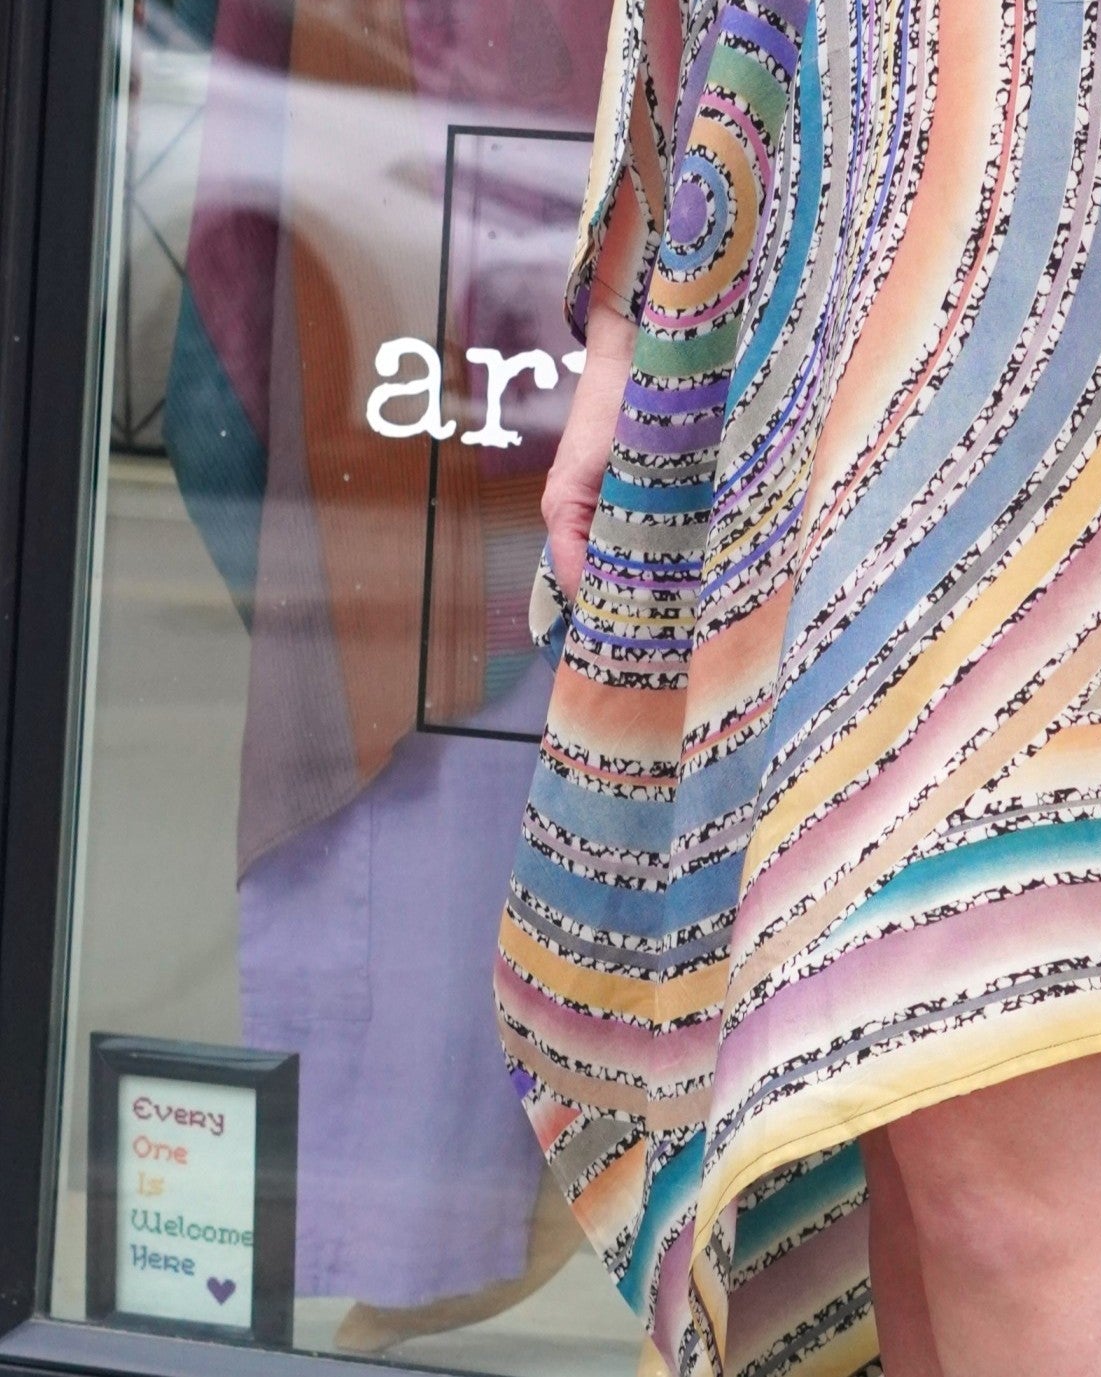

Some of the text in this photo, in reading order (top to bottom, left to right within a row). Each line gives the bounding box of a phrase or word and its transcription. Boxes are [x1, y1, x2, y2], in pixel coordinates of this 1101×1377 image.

[366, 337, 587, 448] ar
[133, 1096, 225, 1137] Every
[133, 1135, 189, 1165] One
[138, 1172, 165, 1197] Is
[131, 1208, 254, 1248] Welcome
[130, 1244, 196, 1276] Here
